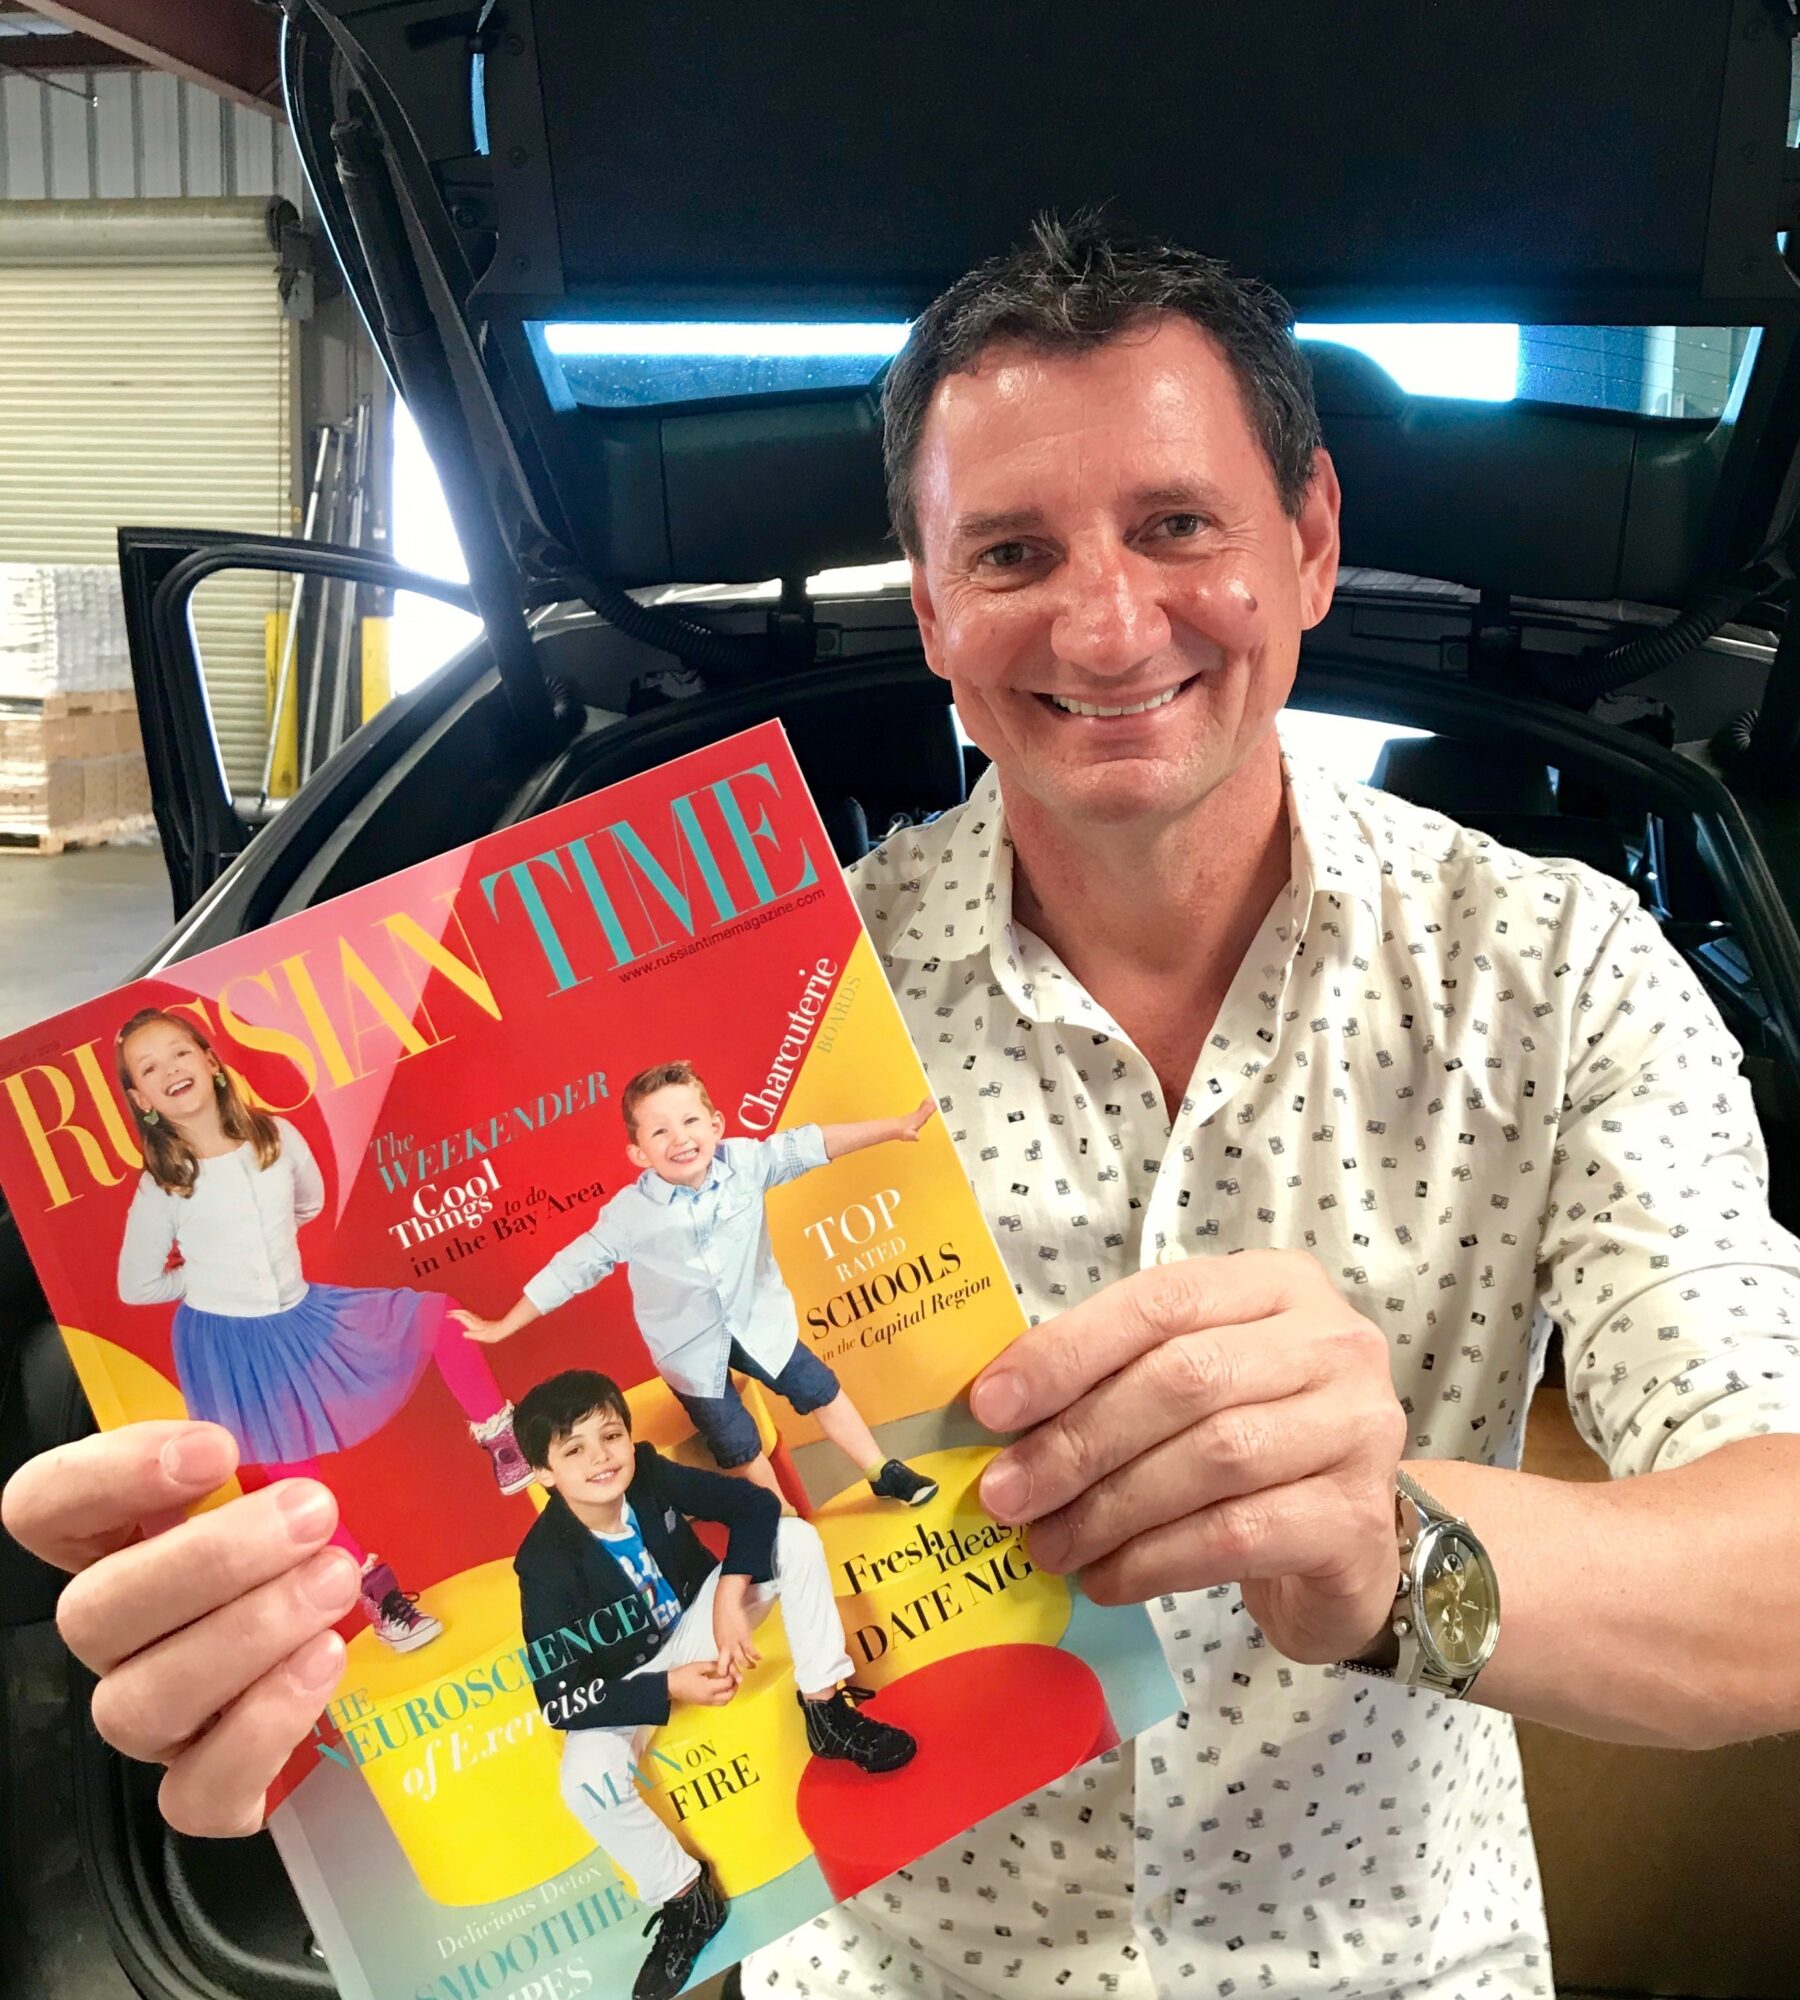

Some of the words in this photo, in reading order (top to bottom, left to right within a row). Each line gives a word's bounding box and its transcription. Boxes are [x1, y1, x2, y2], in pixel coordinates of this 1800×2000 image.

[480, 763, 819, 997] TIME
[618, 888, 826, 983] www.russiantimemagazine.com
[737, 957, 838, 1131] Charcuterie
[817, 975, 861, 1055] BOARDS
[369, 1131, 415, 1165] The
[378, 1071, 610, 1194] WEEKENDER
[388, 1195, 494, 1250] Things
[504, 1198, 521, 1217] to
[525, 1186, 548, 1206] do
[410, 1256, 441, 1278] in
[446, 1235, 487, 1263] the
[491, 1211, 538, 1241] Bay
[546, 1182, 606, 1219] Area
[412, 1158, 503, 1219] Cool
[803, 1188, 901, 1261] TOP
[806, 1242, 961, 1340] SCHOOLS
[834, 1236, 907, 1283] RATED
[822, 1348, 835, 1362] in
[837, 1338, 856, 1355] the
[860, 1299, 927, 1348] Capital
[931, 1275, 992, 1314] Region
[839, 1523, 946, 1596] Fresh
[929, 1521, 1014, 1575] ideas
[852, 1582, 964, 1665] DATE
[961, 1544, 1040, 1607] NIG
[313, 1594, 650, 1770] NEUROSCIENCE
[402, 1738, 443, 1801] of
[444, 1677, 607, 1773] Exercise
[577, 1739, 684, 1820] MAN
[685, 1739, 718, 1768] ON
[665, 1753, 761, 1823] FIRE
[435, 1901, 537, 1960] Delicious
[539, 1866, 604, 1904] Detox
